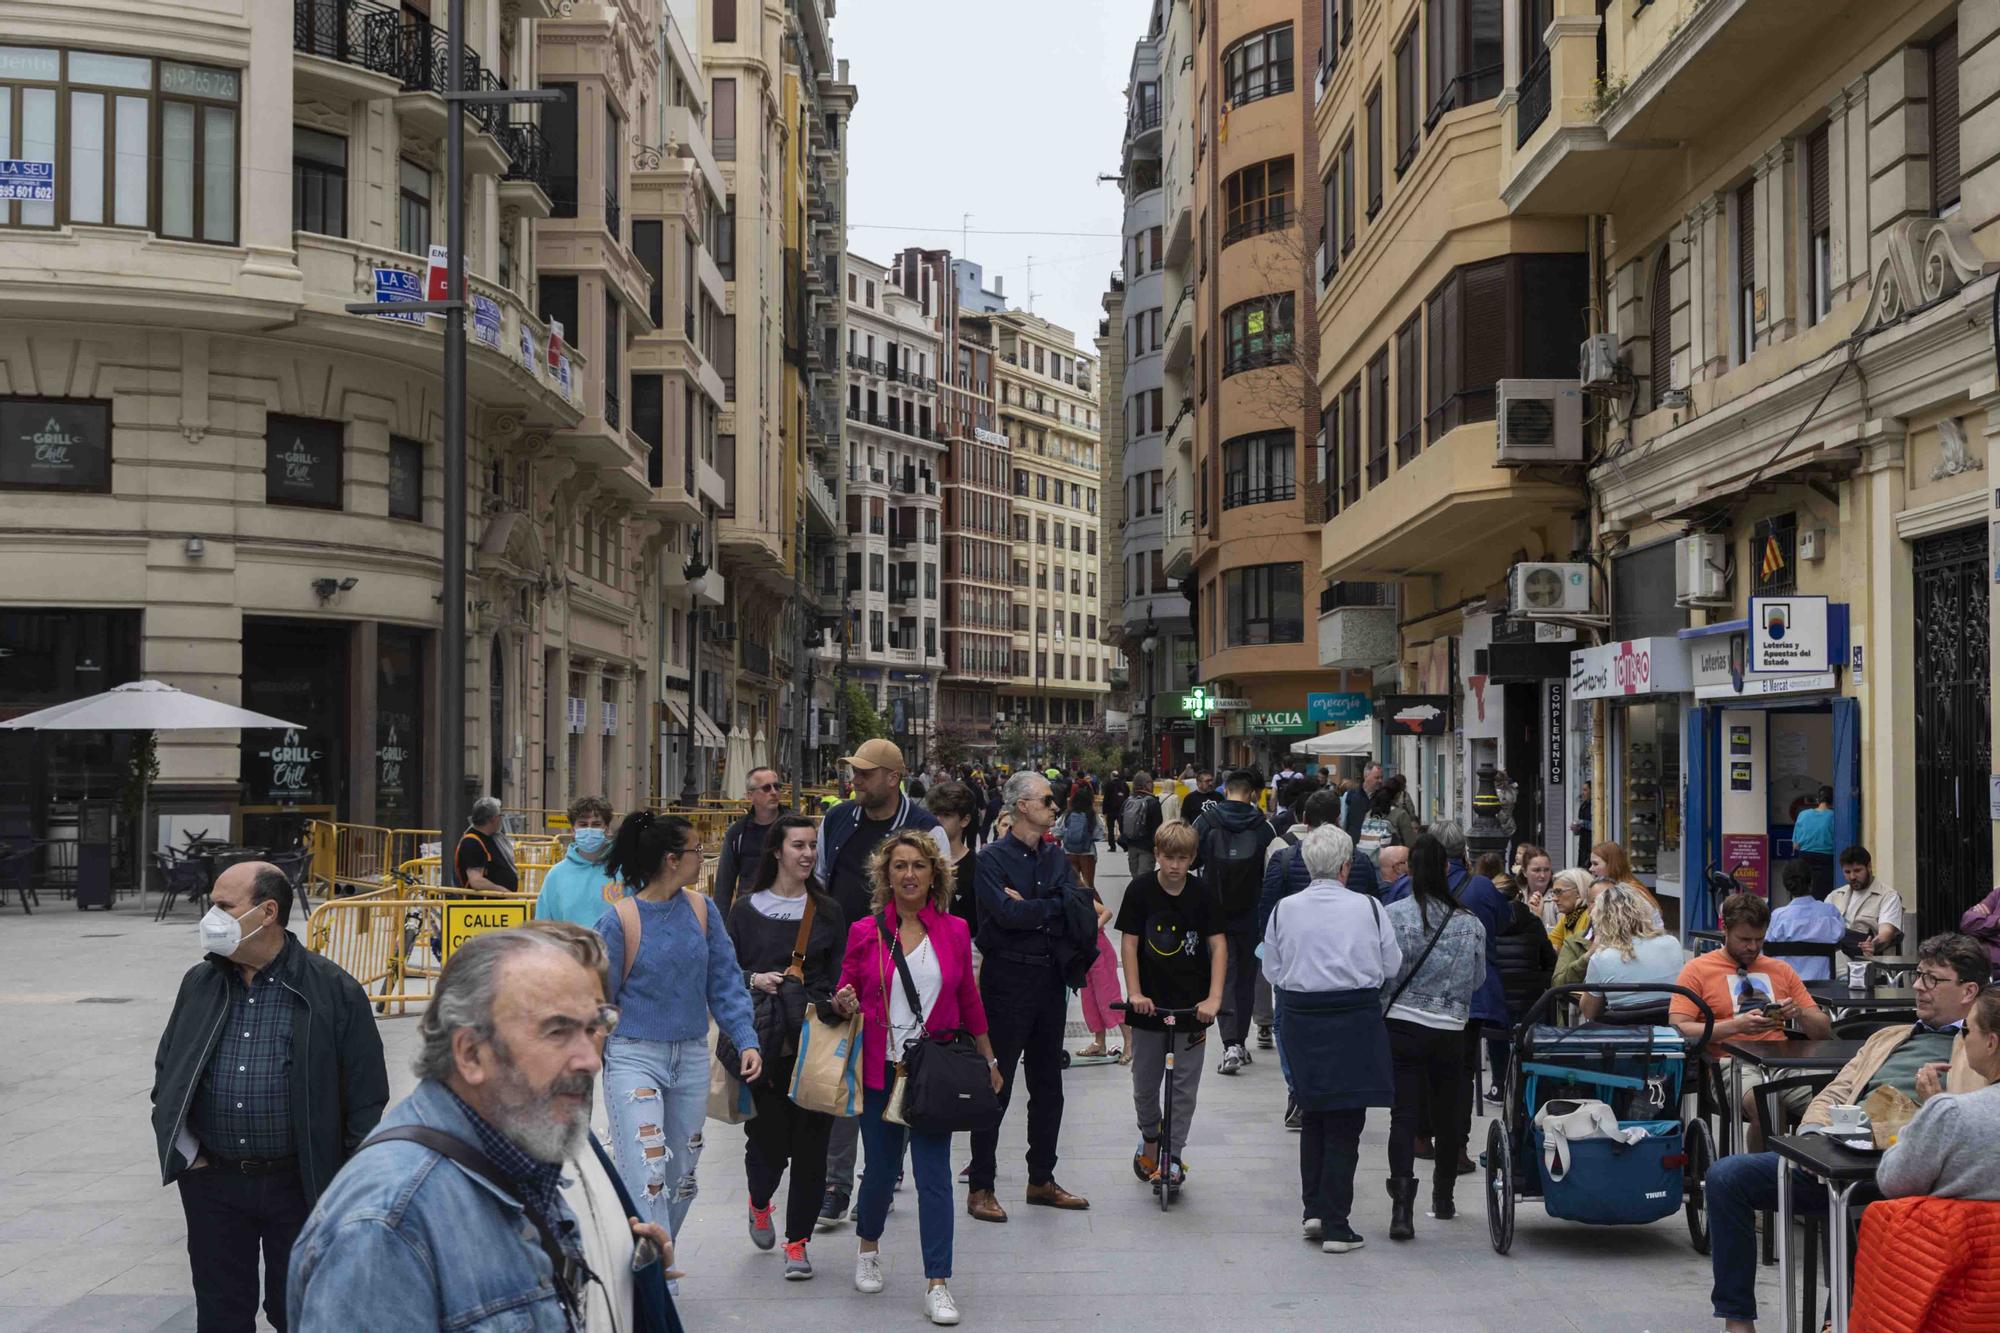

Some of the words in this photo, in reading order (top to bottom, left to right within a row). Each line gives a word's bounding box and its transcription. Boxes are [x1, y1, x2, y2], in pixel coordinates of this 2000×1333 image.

[1, 162, 19, 174] LA
[23, 163, 49, 176] SEU
[16, 186, 33, 198] 601
[34, 186, 52, 199] 602
[380, 272, 398, 286] LA
[33, 433, 72, 445] GRILL
[285, 452, 312, 465] GRILL
[1763, 650, 1798, 660] Apuestas
[1799, 650, 1811, 658] del
[1763, 658, 1790, 667] Estado
[1552, 686, 1561, 783] COMPLEMENTOS
[272, 747, 311, 763] GRILL
[382, 747, 403, 761] GRILL
[273, 761, 309, 789] Chill
[463, 914, 509, 928] CALLE
[1645, 1190, 1667, 1199] THULE
